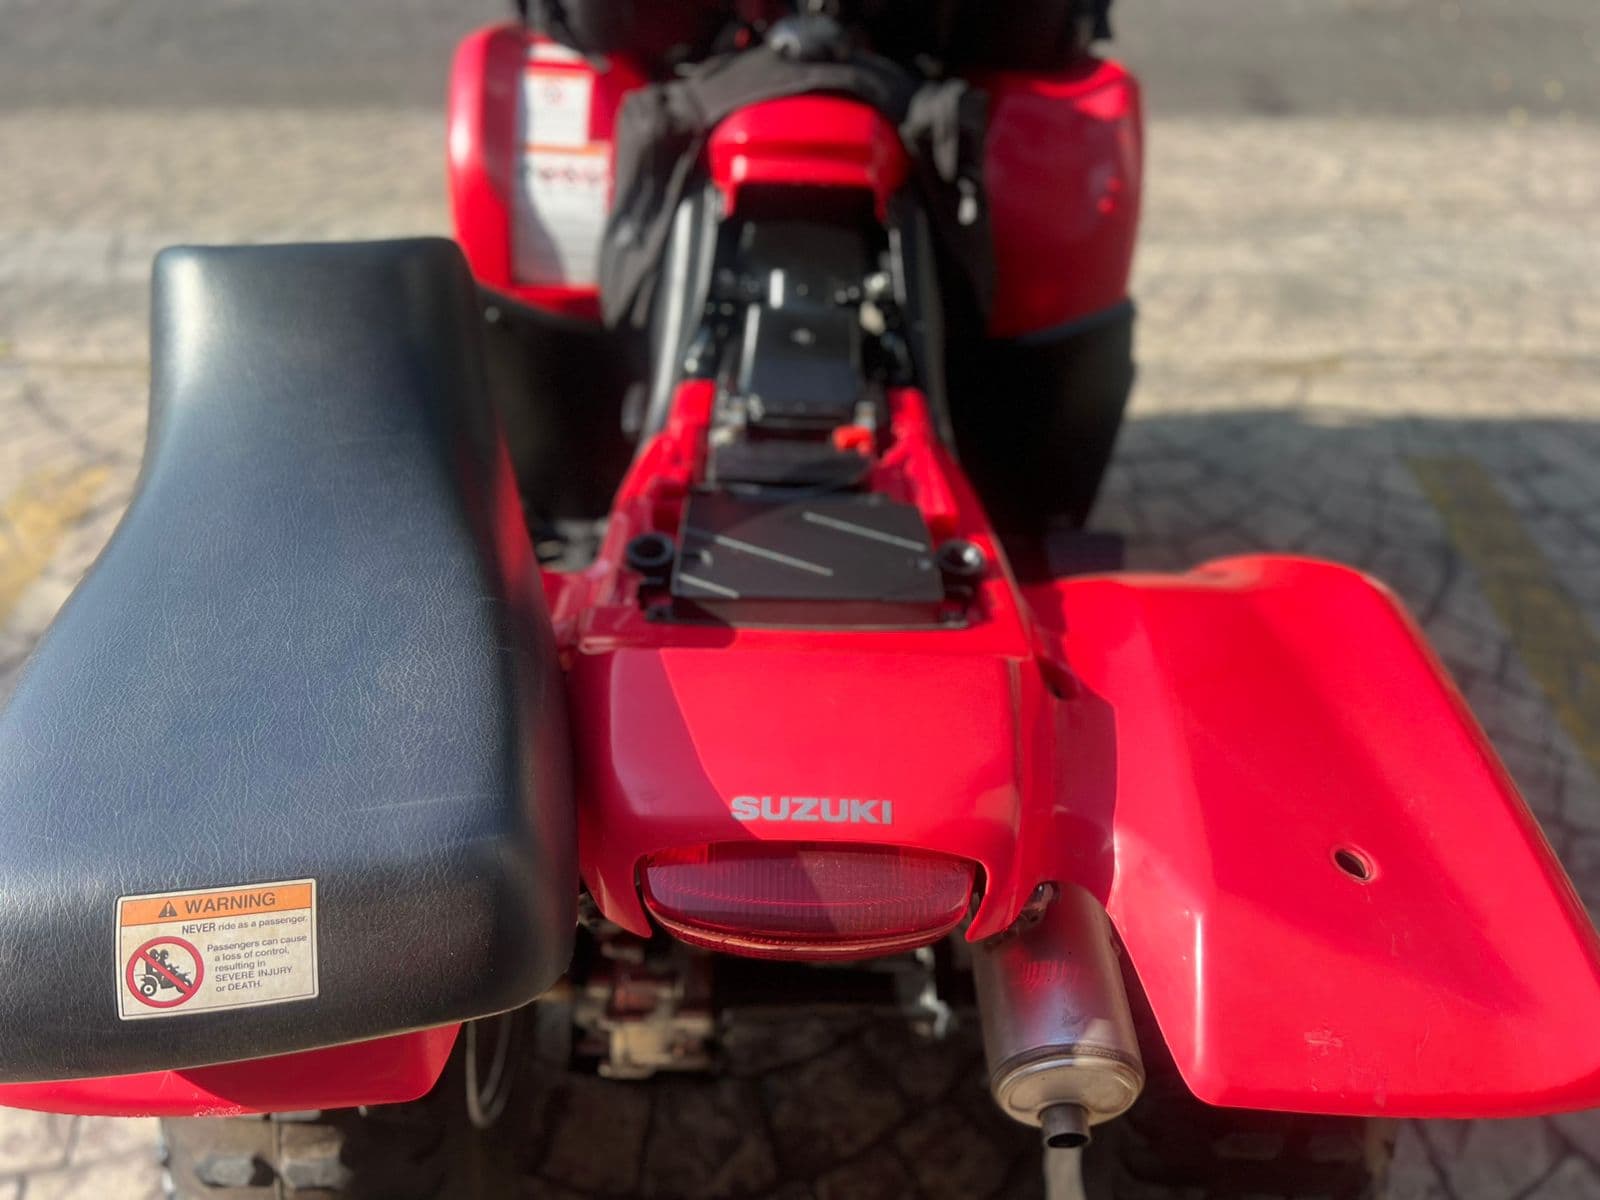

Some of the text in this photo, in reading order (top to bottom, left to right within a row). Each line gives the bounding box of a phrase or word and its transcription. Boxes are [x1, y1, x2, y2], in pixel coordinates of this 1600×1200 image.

[731, 795, 892, 824] SUZUKI
[185, 892, 276, 914] WARNING
[182, 923, 216, 934] NEVER
[218, 921, 236, 931] ride
[207, 935, 307, 953] Passengers can cause
[222, 951, 241, 961] loss
[244, 951, 253, 959] of
[215, 960, 254, 972] resulting
[216, 966, 292, 983] SEVERE INJURY
